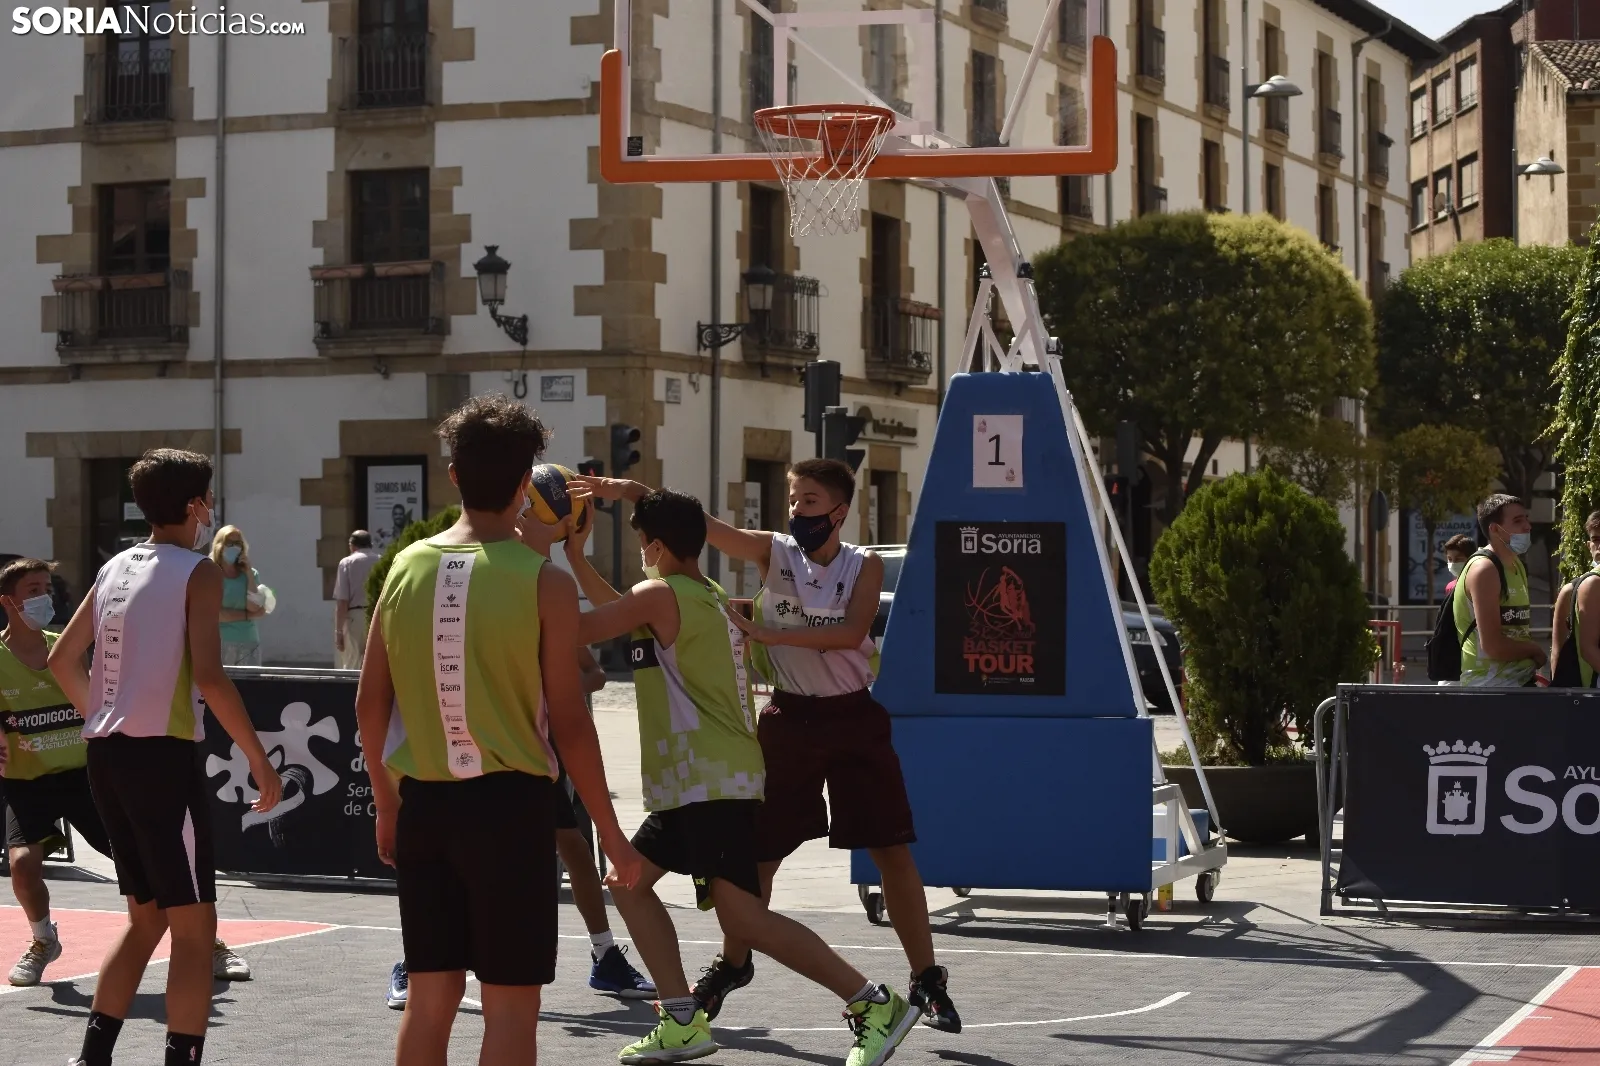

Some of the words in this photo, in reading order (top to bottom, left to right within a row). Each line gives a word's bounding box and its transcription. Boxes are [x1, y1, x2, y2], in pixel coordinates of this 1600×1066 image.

[988, 434, 1006, 466] 1
[374, 481, 399, 493] SOMOS
[980, 533, 1042, 554] Soria
[963, 639, 1036, 654] BASKET
[963, 654, 1034, 674] TOUR
[18, 708, 83, 728] #YODIGOCE
[344, 801, 362, 815] de
[1500, 765, 1600, 834] So
